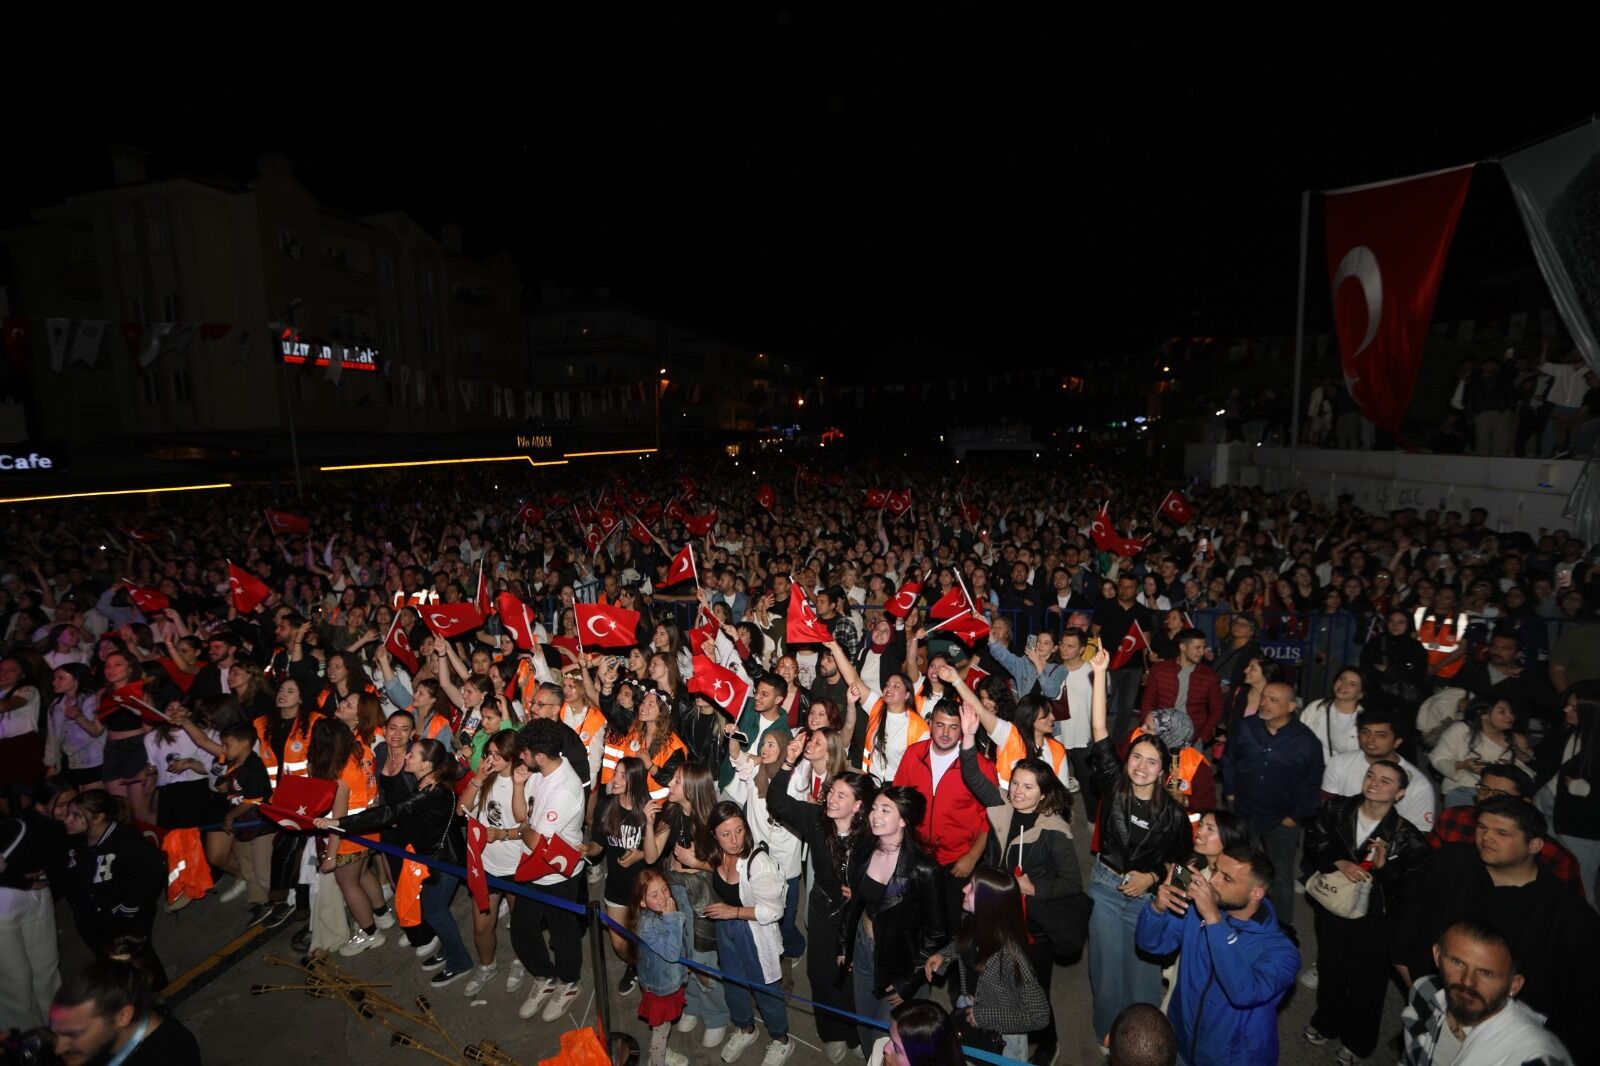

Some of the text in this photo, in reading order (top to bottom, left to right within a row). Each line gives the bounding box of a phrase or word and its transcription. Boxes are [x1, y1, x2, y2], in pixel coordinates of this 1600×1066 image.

[281, 340, 332, 360] uzmn
[0, 452, 53, 470] Cafe
[93, 853, 116, 884] H
